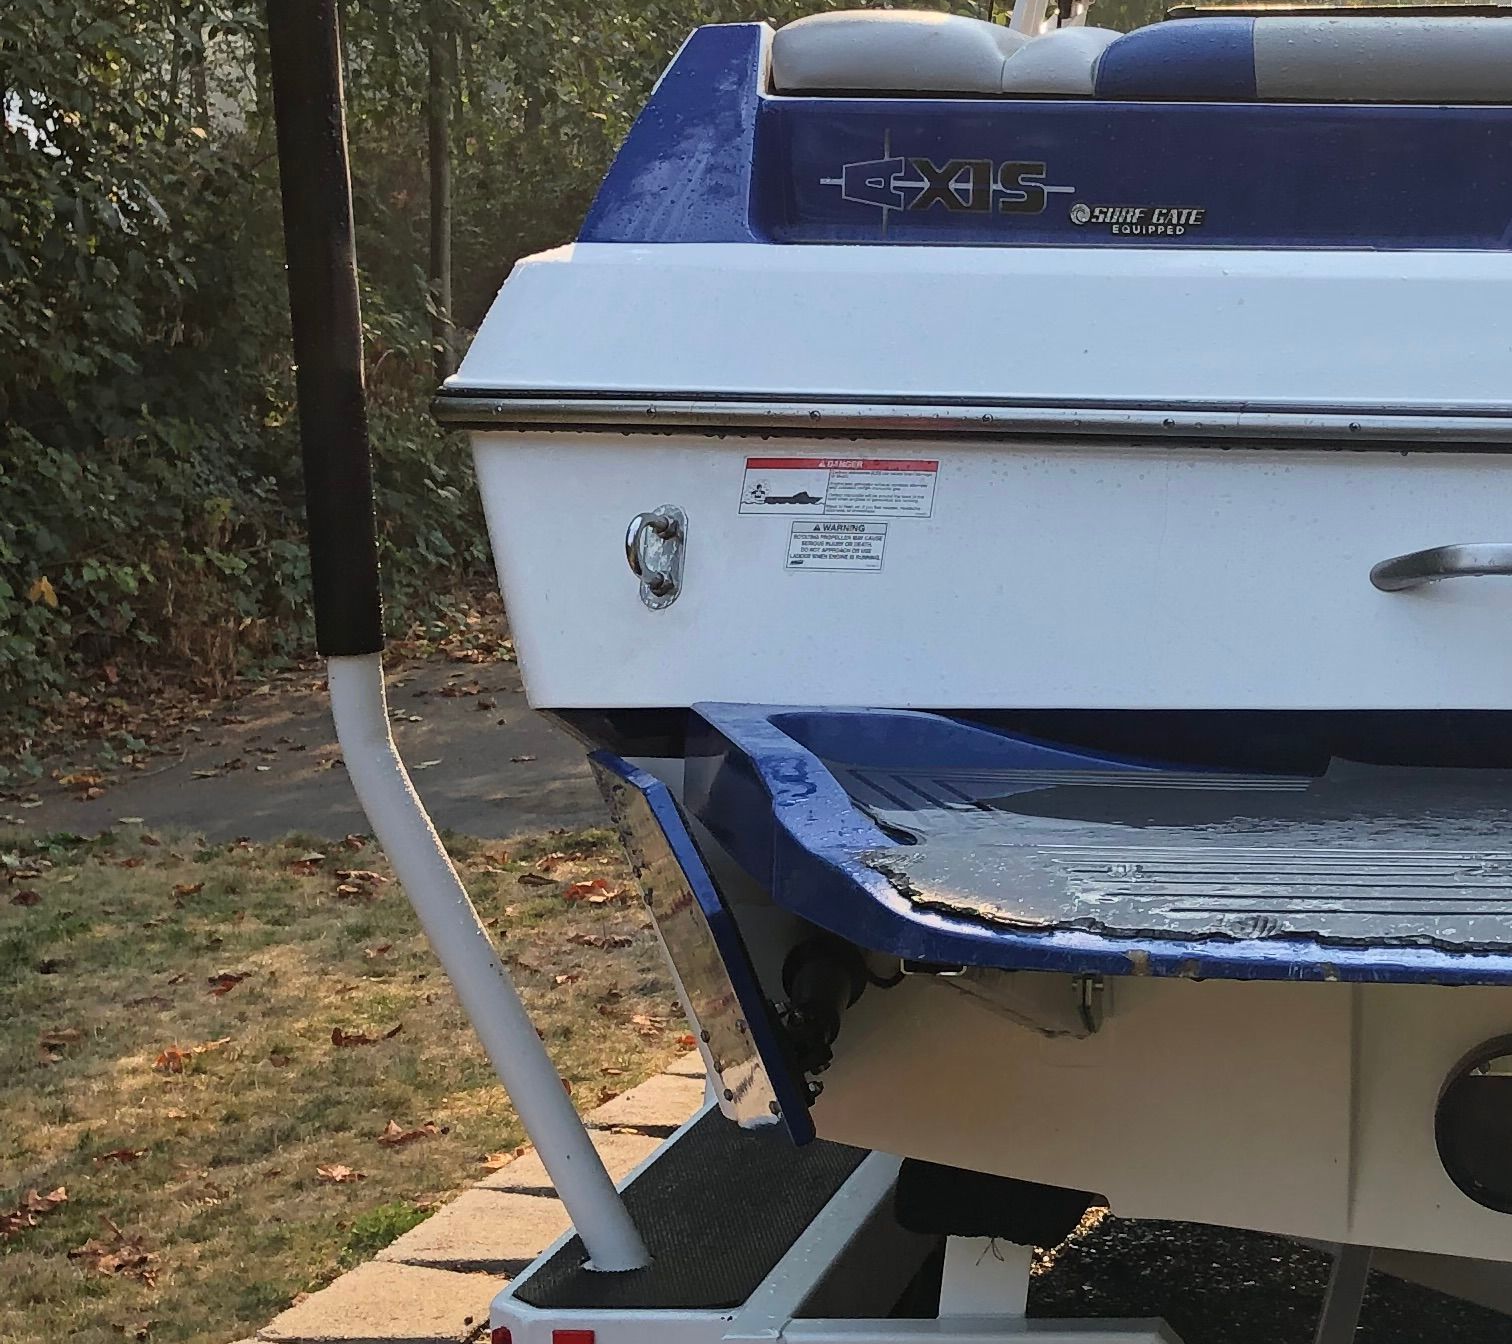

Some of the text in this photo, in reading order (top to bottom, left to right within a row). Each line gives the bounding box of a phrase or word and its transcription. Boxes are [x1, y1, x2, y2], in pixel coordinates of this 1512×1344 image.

[842, 156, 1048, 214] AXIS
[1091, 207, 1206, 225] SURF GATE
[1112, 224, 1185, 235] EQUIPPED
[827, 460, 864, 469] DANGER
[823, 524, 865, 532] WARNING
